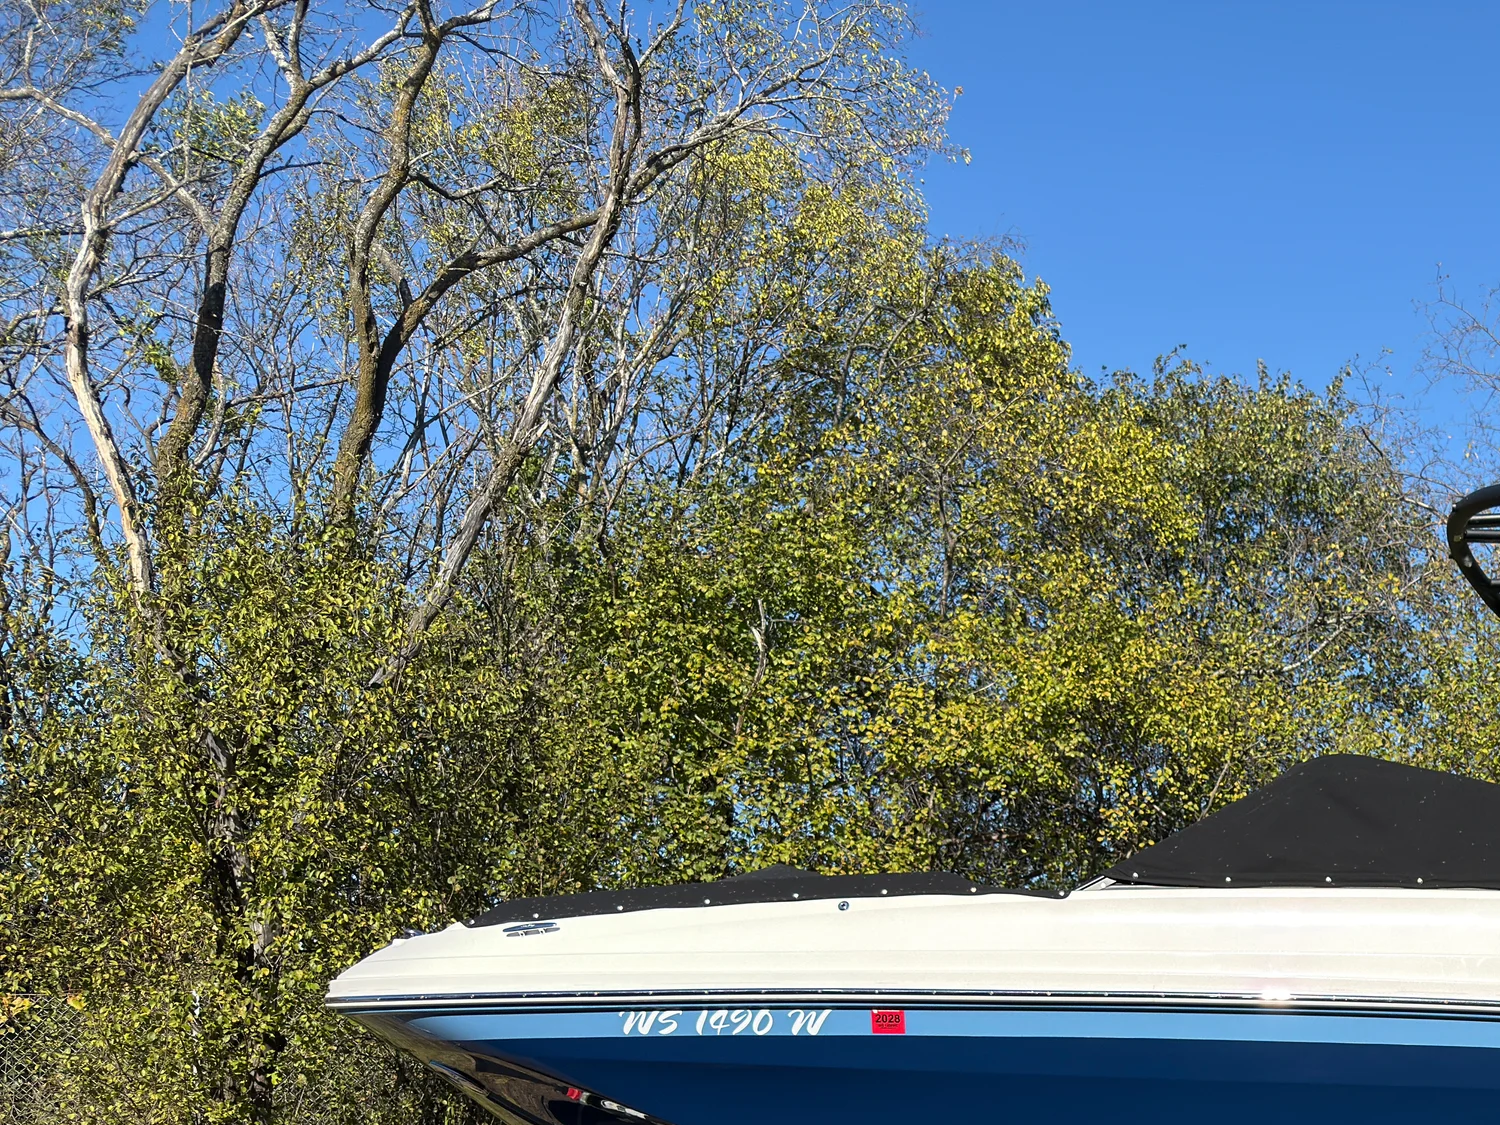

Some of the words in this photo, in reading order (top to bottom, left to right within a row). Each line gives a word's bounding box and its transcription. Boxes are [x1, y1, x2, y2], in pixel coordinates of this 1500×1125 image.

[619, 1010, 682, 1035] WS
[696, 1009, 773, 1035] 1490
[787, 1009, 832, 1035] W
[875, 1013, 901, 1024] 2028
